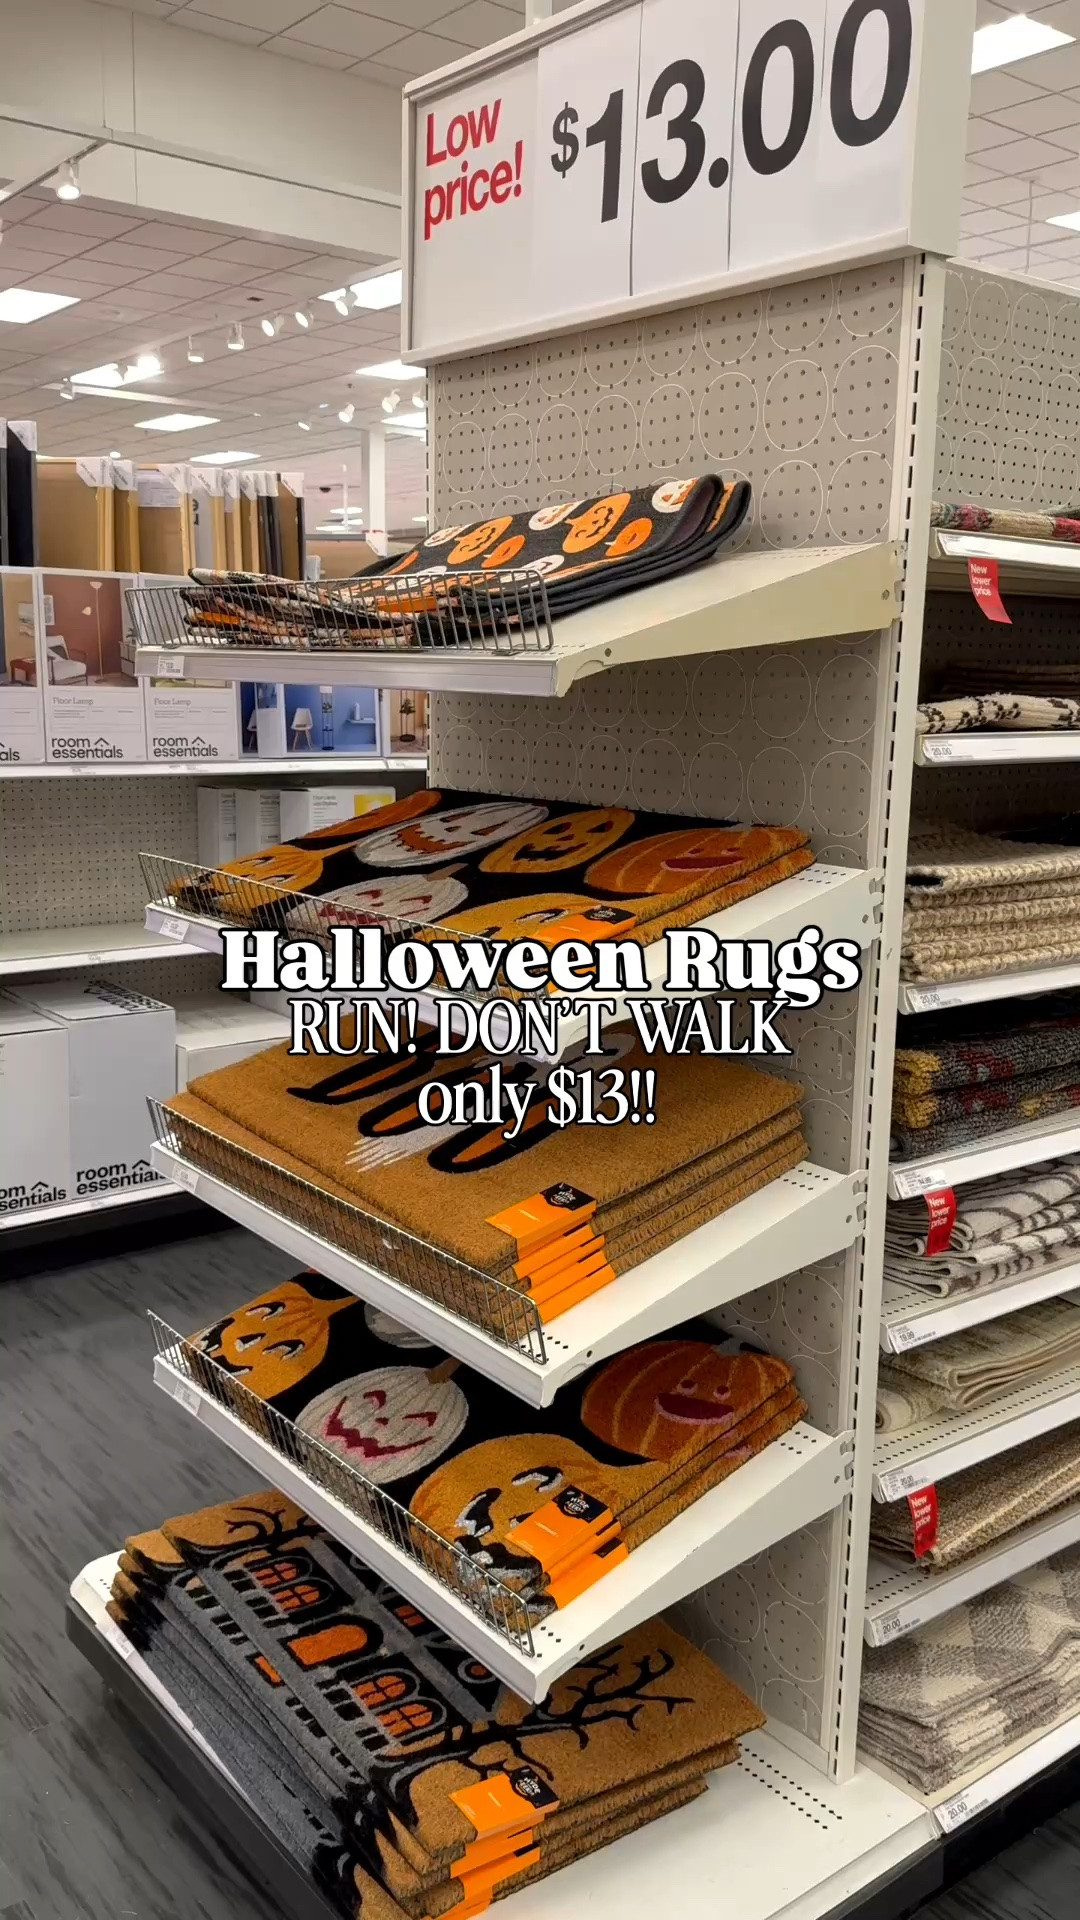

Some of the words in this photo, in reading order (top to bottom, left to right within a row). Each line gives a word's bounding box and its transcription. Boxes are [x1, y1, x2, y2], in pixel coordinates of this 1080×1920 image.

[551, 0, 913, 224] $13.00
[426, 98, 502, 167] Low
[424, 140, 524, 241] price!
[970, 563, 988, 575] New
[971, 574, 992, 586] lower
[973, 586, 992, 597] price
[51, 737, 90, 748] room
[152, 736, 188, 747] room
[52, 745, 123, 759] essentials
[153, 744, 218, 758] essentials
[76, 1162, 127, 1183] room
[0, 1184, 26, 1200] om
[0, 1187, 67, 1212] sentials
[929, 1196, 946, 1209] New
[931, 1205, 951, 1219] lower
[931, 1216, 948, 1230] price
[911, 1495, 928, 1509] New
[913, 1503, 932, 1519] lower
[915, 1514, 931, 1531] price
[948, 1801, 968, 1820] 20.00
